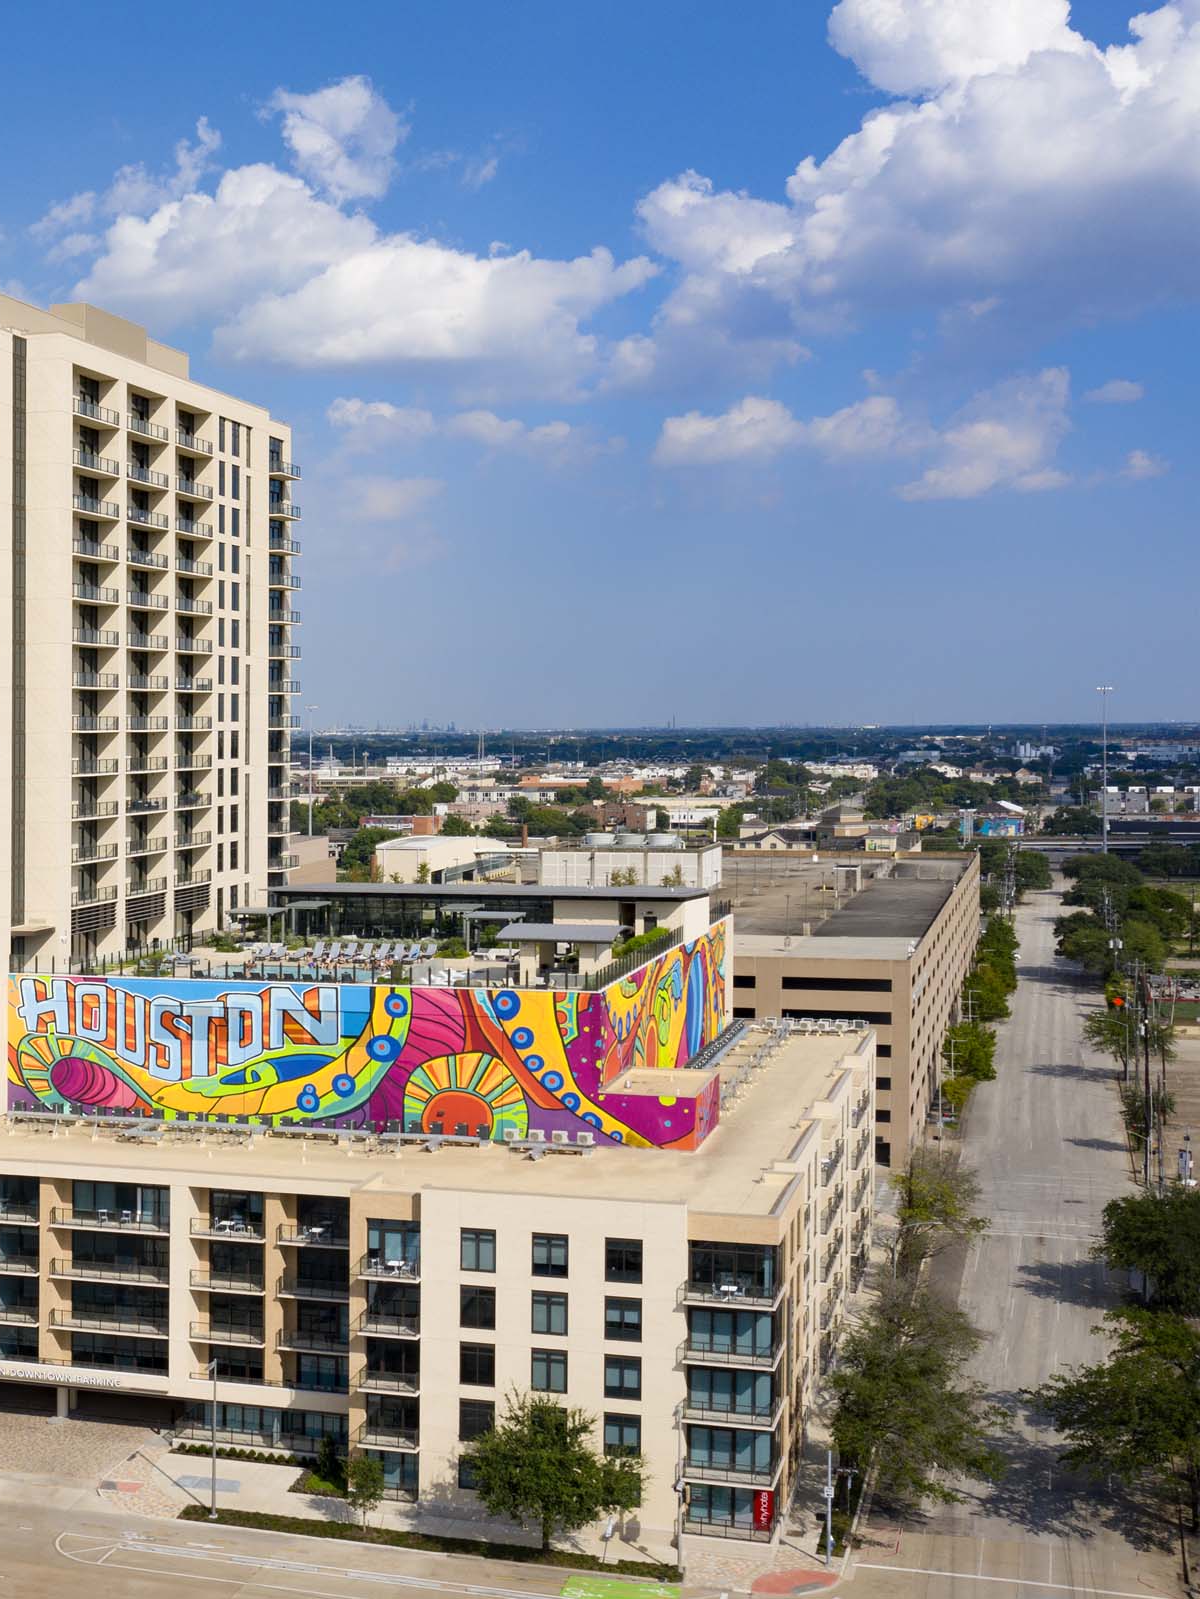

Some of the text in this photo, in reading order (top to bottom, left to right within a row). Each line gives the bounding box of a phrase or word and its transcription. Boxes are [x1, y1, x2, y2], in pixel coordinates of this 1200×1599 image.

[17, 977, 341, 1082] HOUSTON
[9, 1367, 72, 1383] DOWNTOWN
[75, 1374, 121, 1387] PARKING
